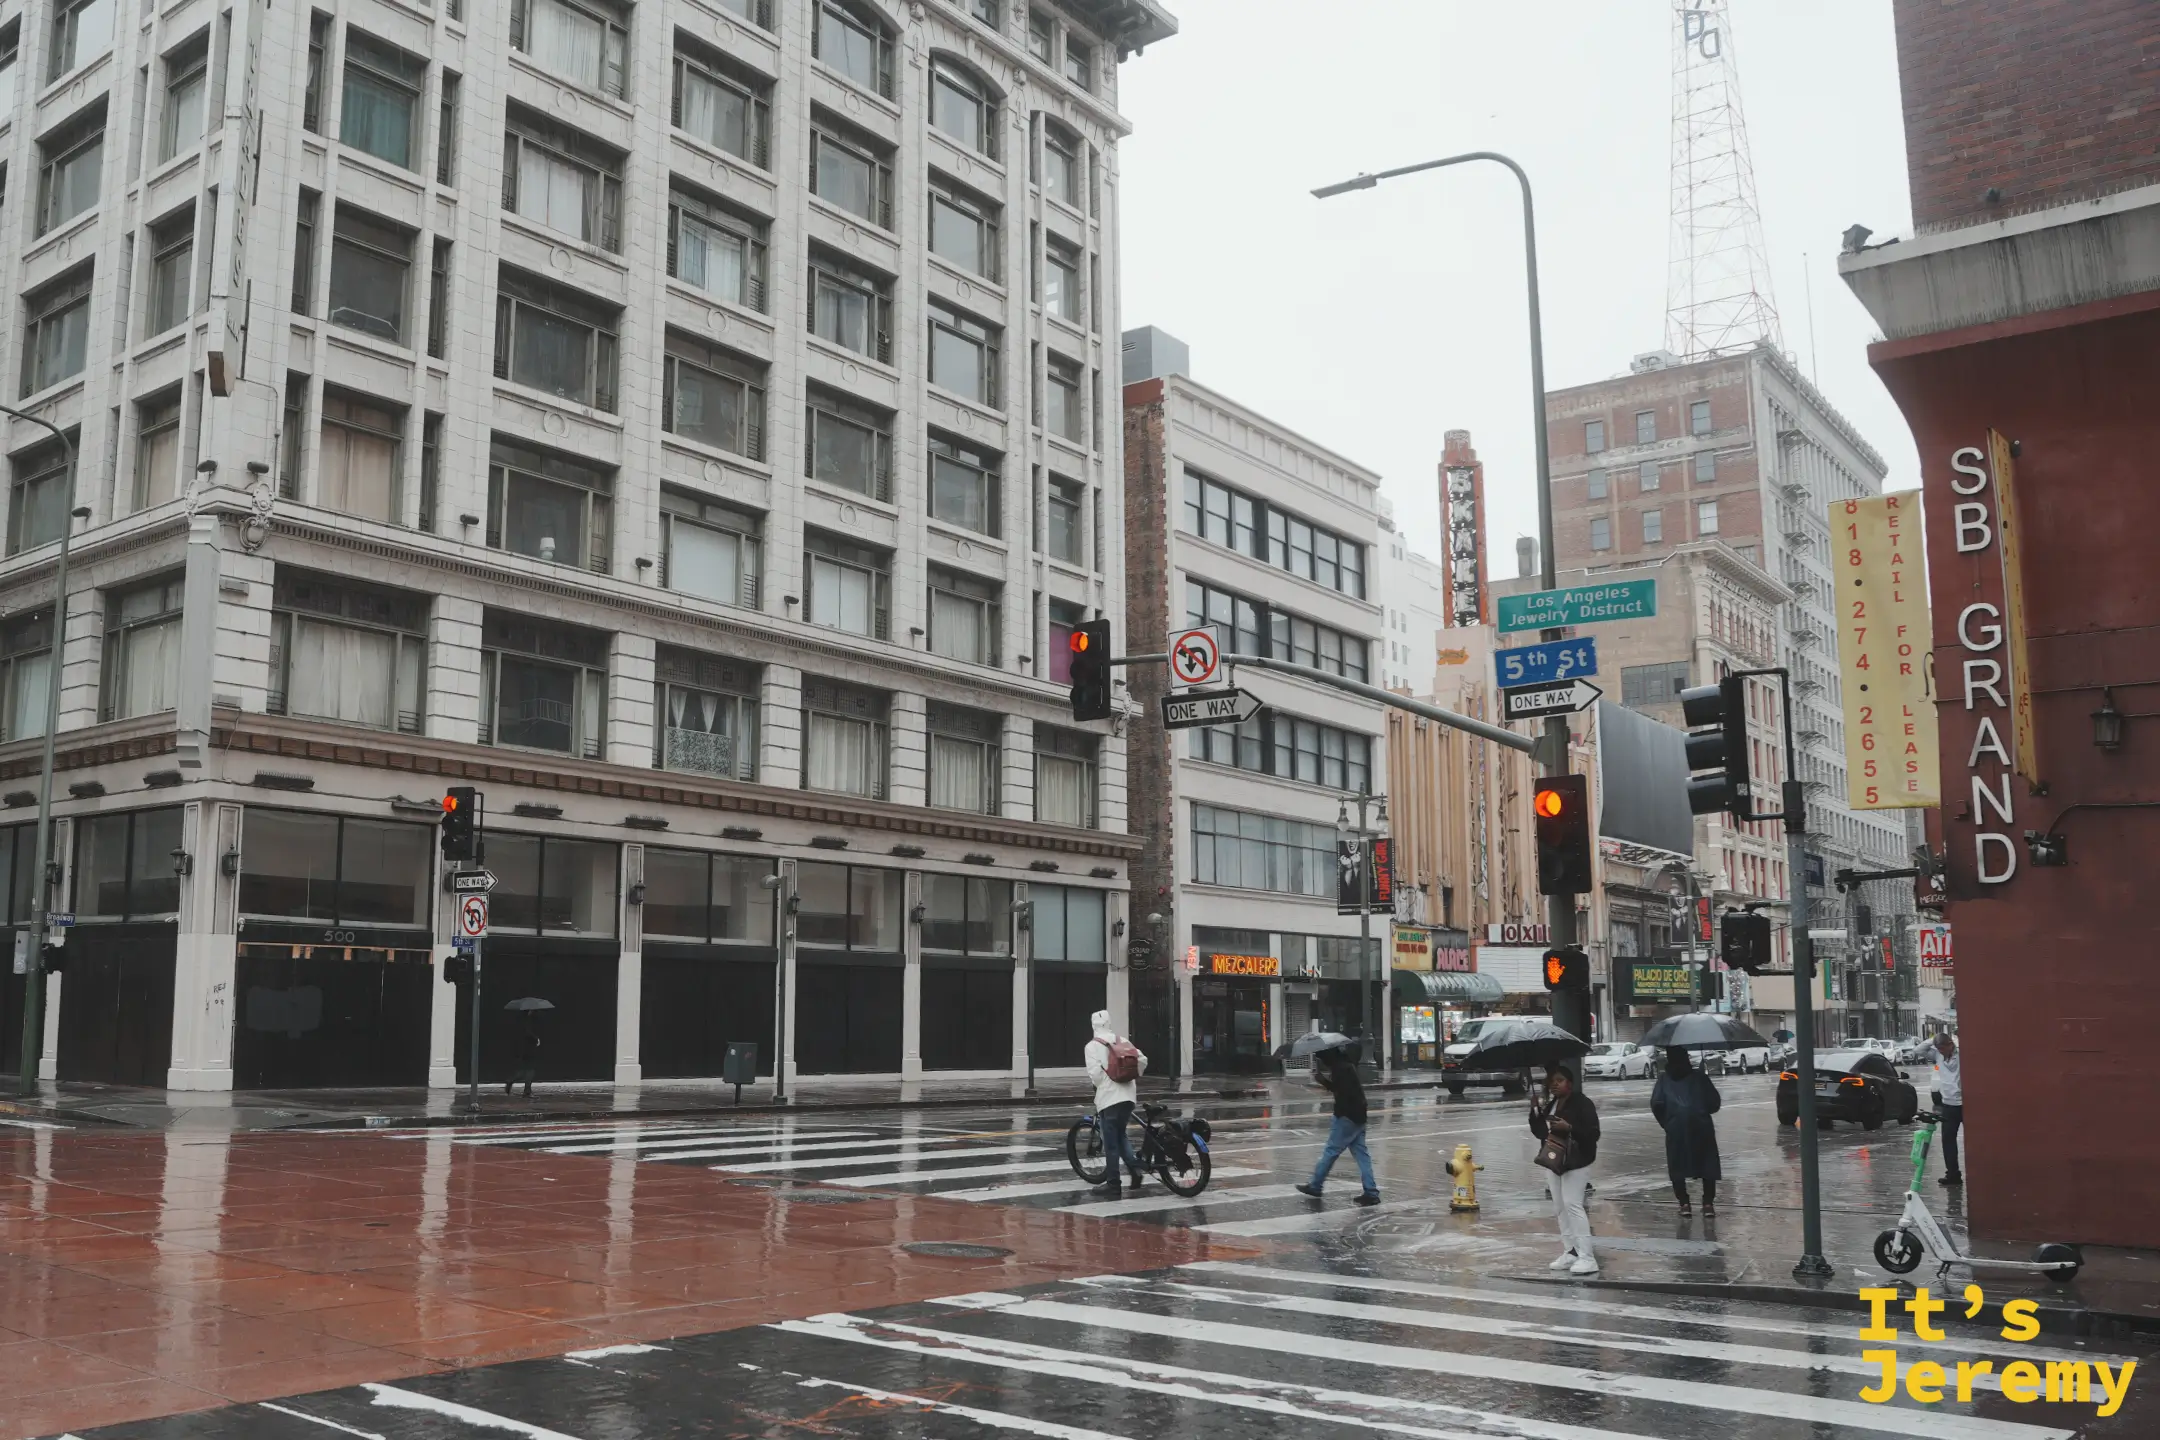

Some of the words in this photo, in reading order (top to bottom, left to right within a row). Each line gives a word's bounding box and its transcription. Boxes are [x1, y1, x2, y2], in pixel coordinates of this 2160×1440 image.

[1950, 446, 1992, 553] SB
[1886, 496, 1905, 603] RETAIL
[1526, 595, 1554, 609] Los
[1562, 587, 1631, 605] Angeles
[1507, 609, 1570, 627] Jewelry
[1579, 599, 1643, 618] District
[1897, 625, 1913, 675] FOR
[1505, 651, 1548, 680] 5th
[1558, 647, 1588, 671] St
[1168, 703, 1198, 720] ONE
[1206, 698, 1238, 716] WAY
[1514, 693, 1542, 709] ONE
[1545, 689, 1574, 705] WAY
[1902, 704, 1919, 792] LEASE
[1957, 602, 2018, 885] GRAND
[457, 878, 470, 887] ONE
[1377, 865, 1391, 902] FUNNY
[46, 912, 75, 923] Broadway
[323, 930, 355, 943] 500
[1213, 954, 1279, 976] MEZCALERO
[1633, 968, 1662, 981] PALACIO
[1663, 969, 1673, 981] DE
[1673, 969, 1688, 982] ORO
